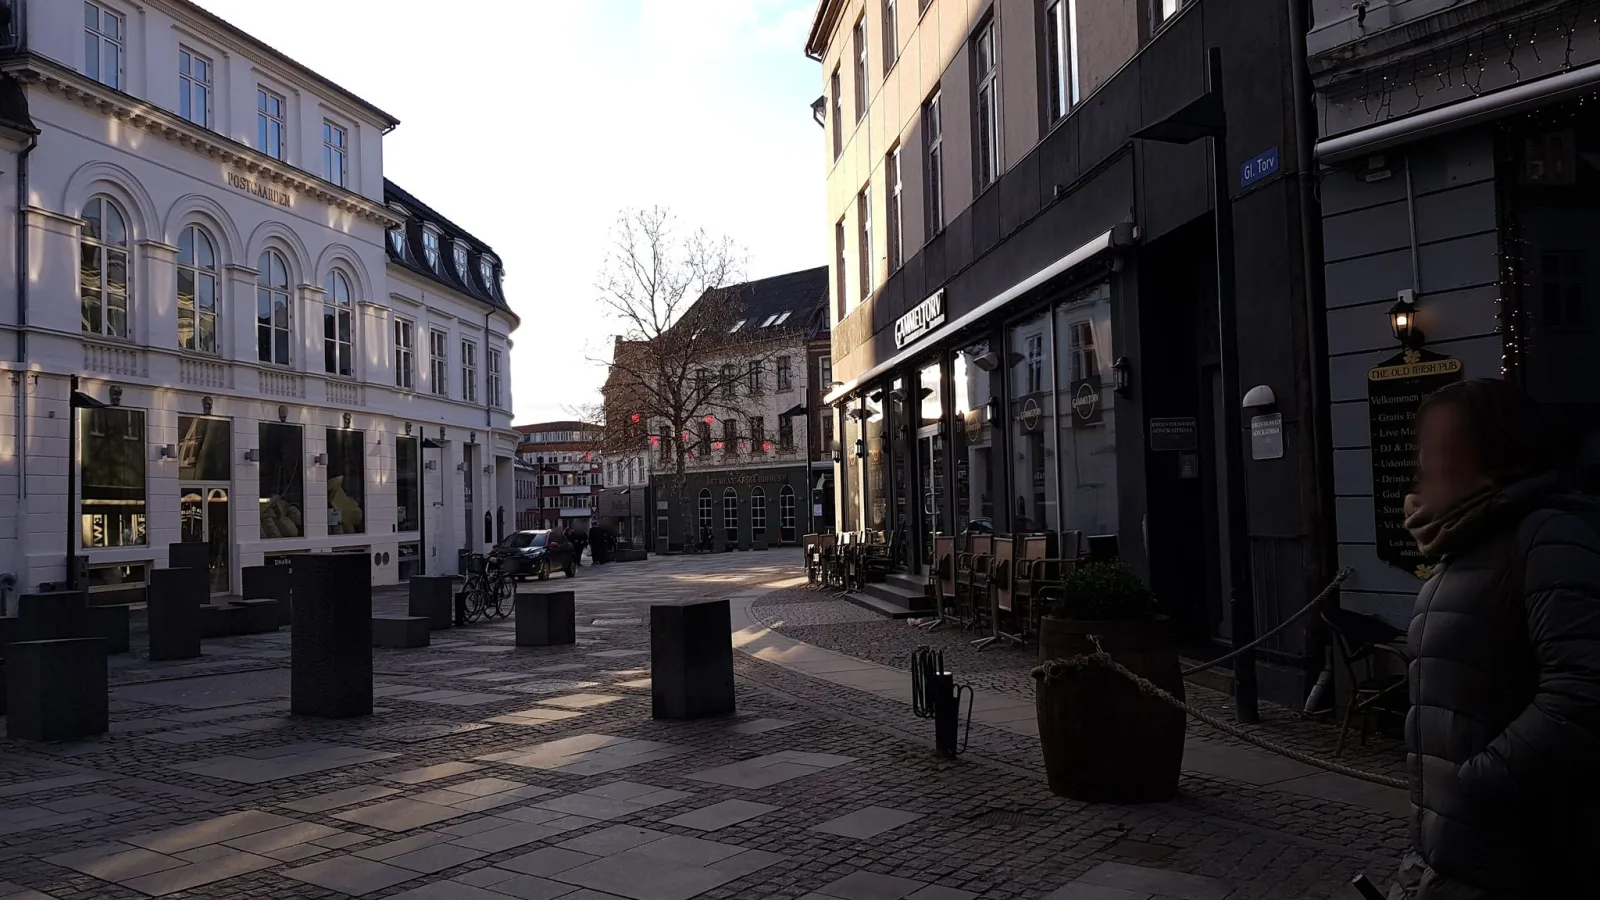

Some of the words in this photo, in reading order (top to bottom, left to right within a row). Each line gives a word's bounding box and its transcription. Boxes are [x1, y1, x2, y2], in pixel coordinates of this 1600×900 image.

[1244, 164, 1255, 180] Gl.
[1257, 157, 1275, 174] Torv
[227, 171, 291, 207] POSTGAARDEN
[895, 288, 945, 348] GAMMELTORV
[1371, 369, 1389, 379] THE
[1392, 366, 1410, 377] OLD
[1412, 363, 1436, 375] IRISH
[1438, 360, 1458, 371] PUB
[1371, 393, 1419, 405] Velkommen
[1378, 412, 1405, 422] Gratis
[1379, 429, 1399, 437] Live
[1400, 427, 1416, 436] Mu
[1380, 444, 1392, 452] DJ
[1394, 443, 1402, 452] &
[1381, 474, 1410, 483] Drinks
[1382, 490, 1401, 499] God
[1383, 506, 1405, 514] Stors
[1384, 521, 1394, 529] Vi
